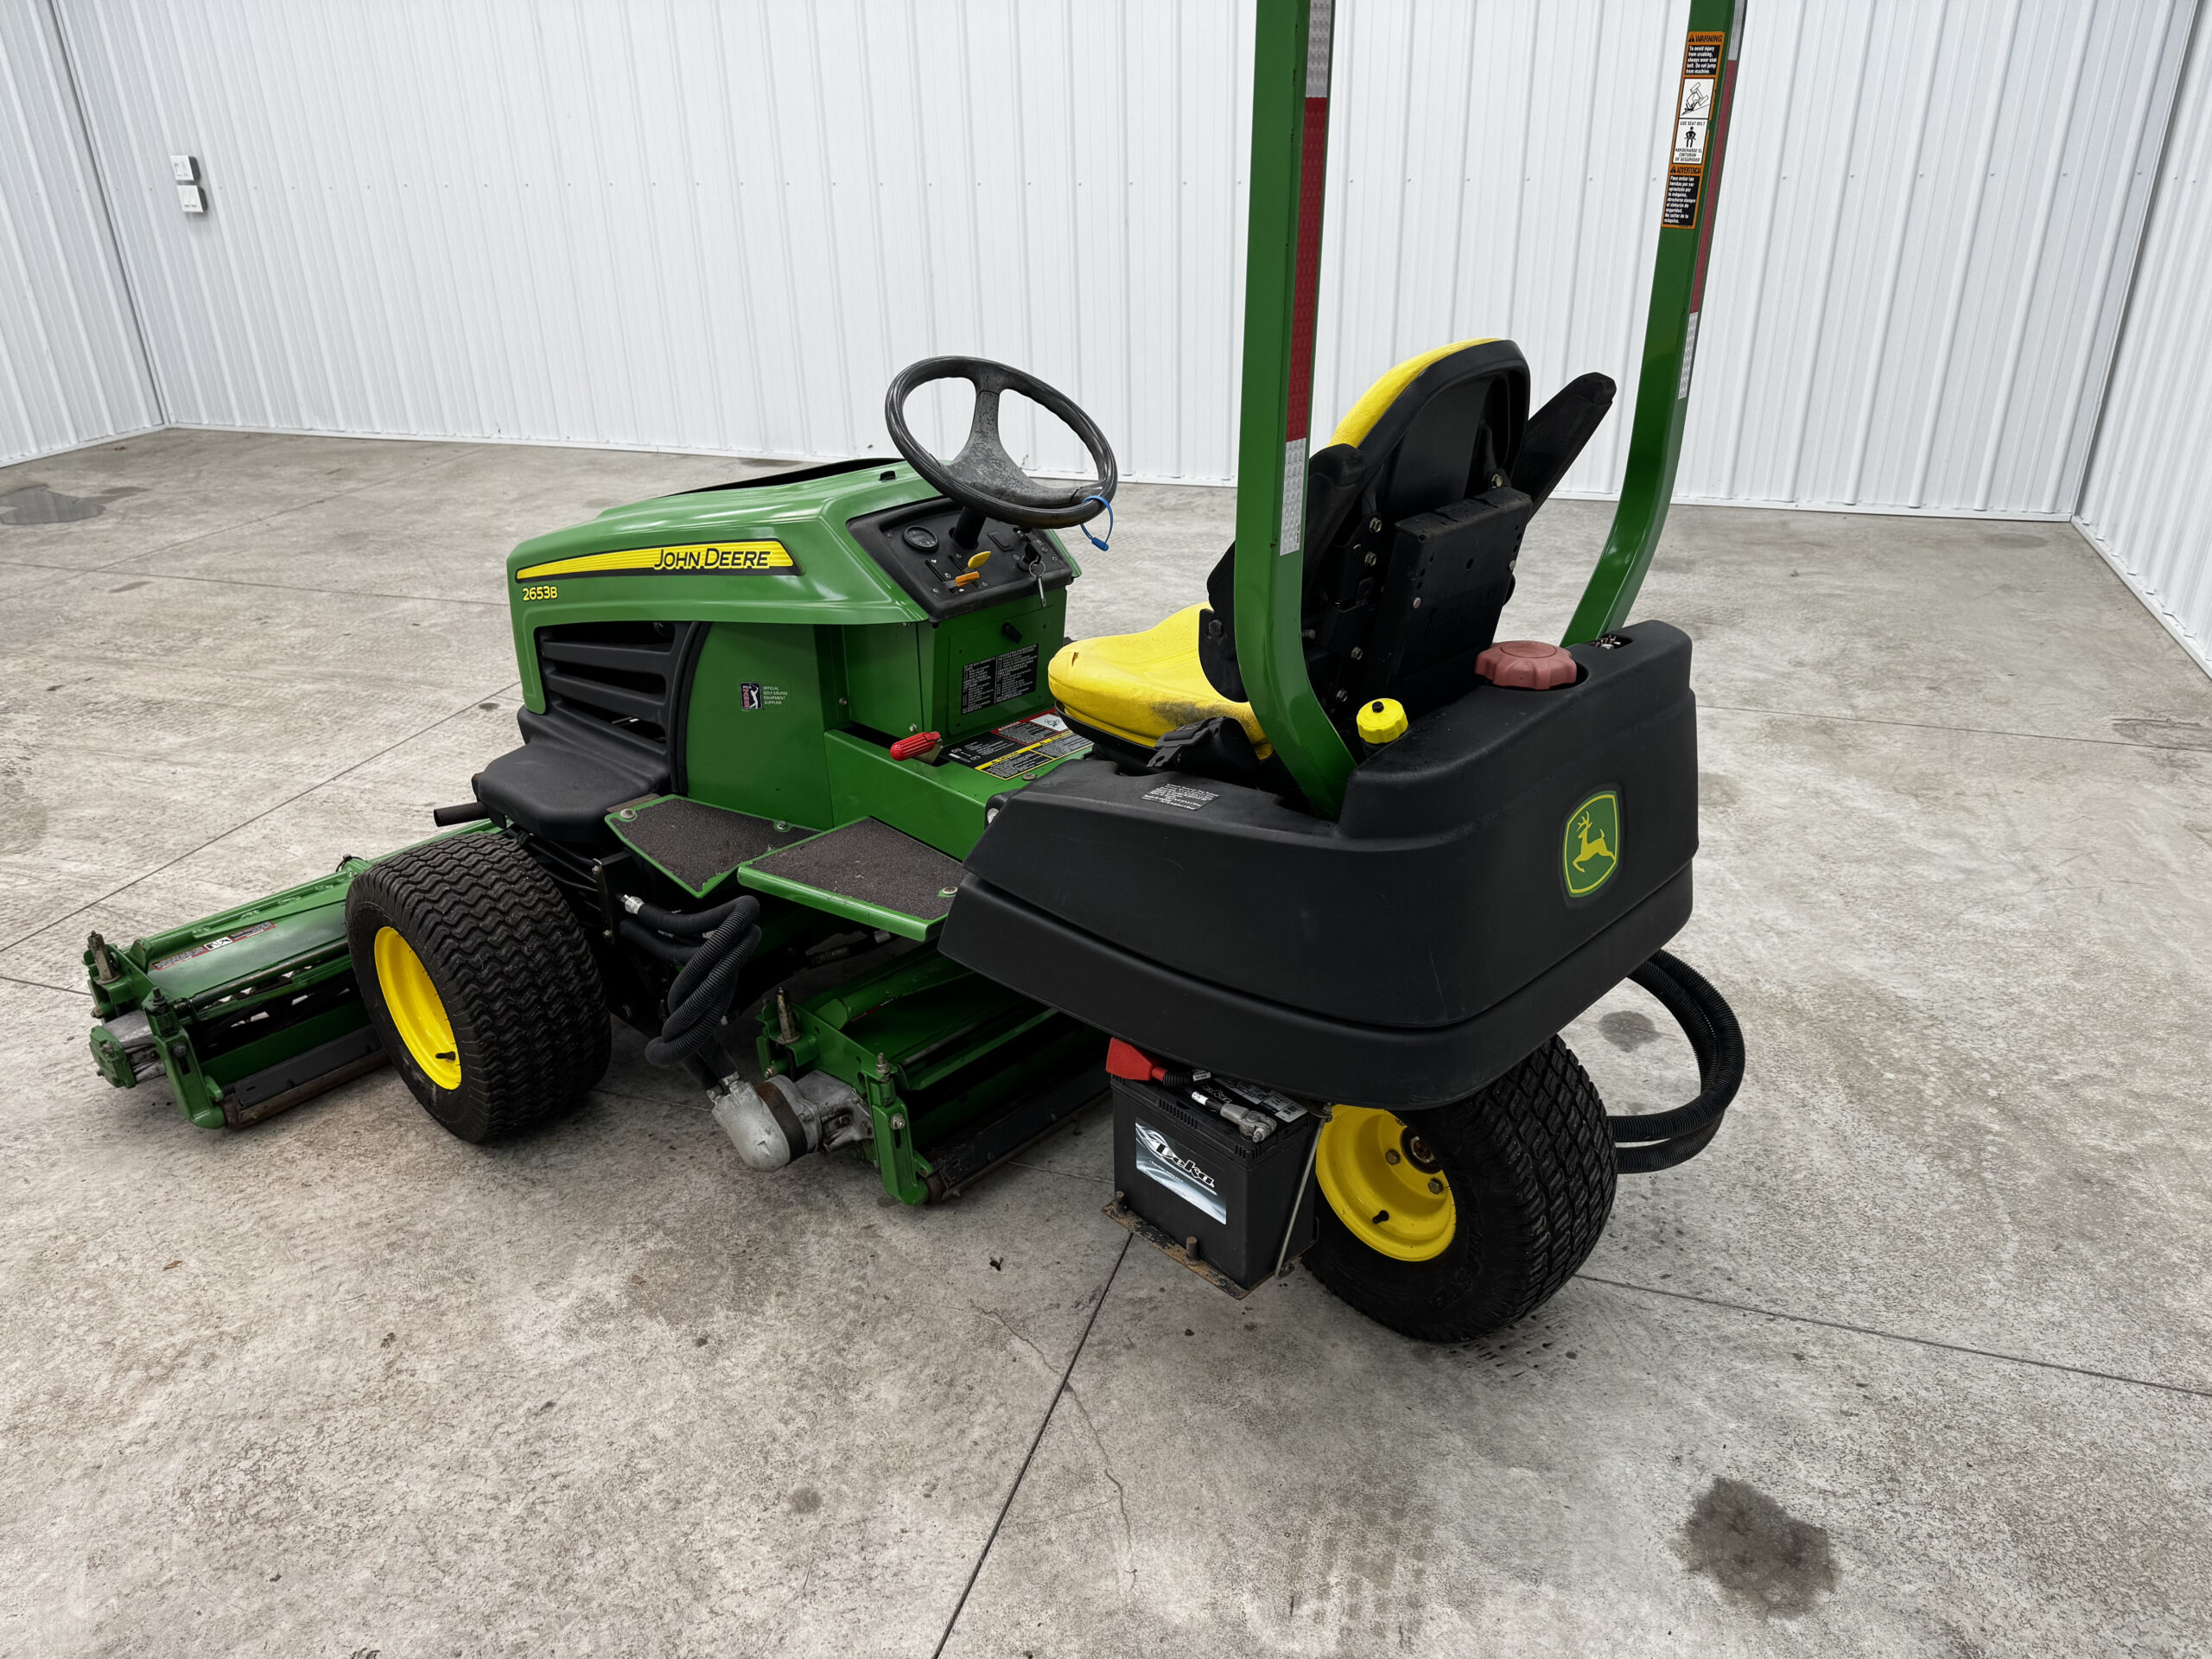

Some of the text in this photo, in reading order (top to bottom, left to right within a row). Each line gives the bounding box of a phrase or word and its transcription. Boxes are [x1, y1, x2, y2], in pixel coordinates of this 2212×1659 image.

[654, 548, 771, 568] JOHN DEERE
[522, 585, 558, 601] 2653B
